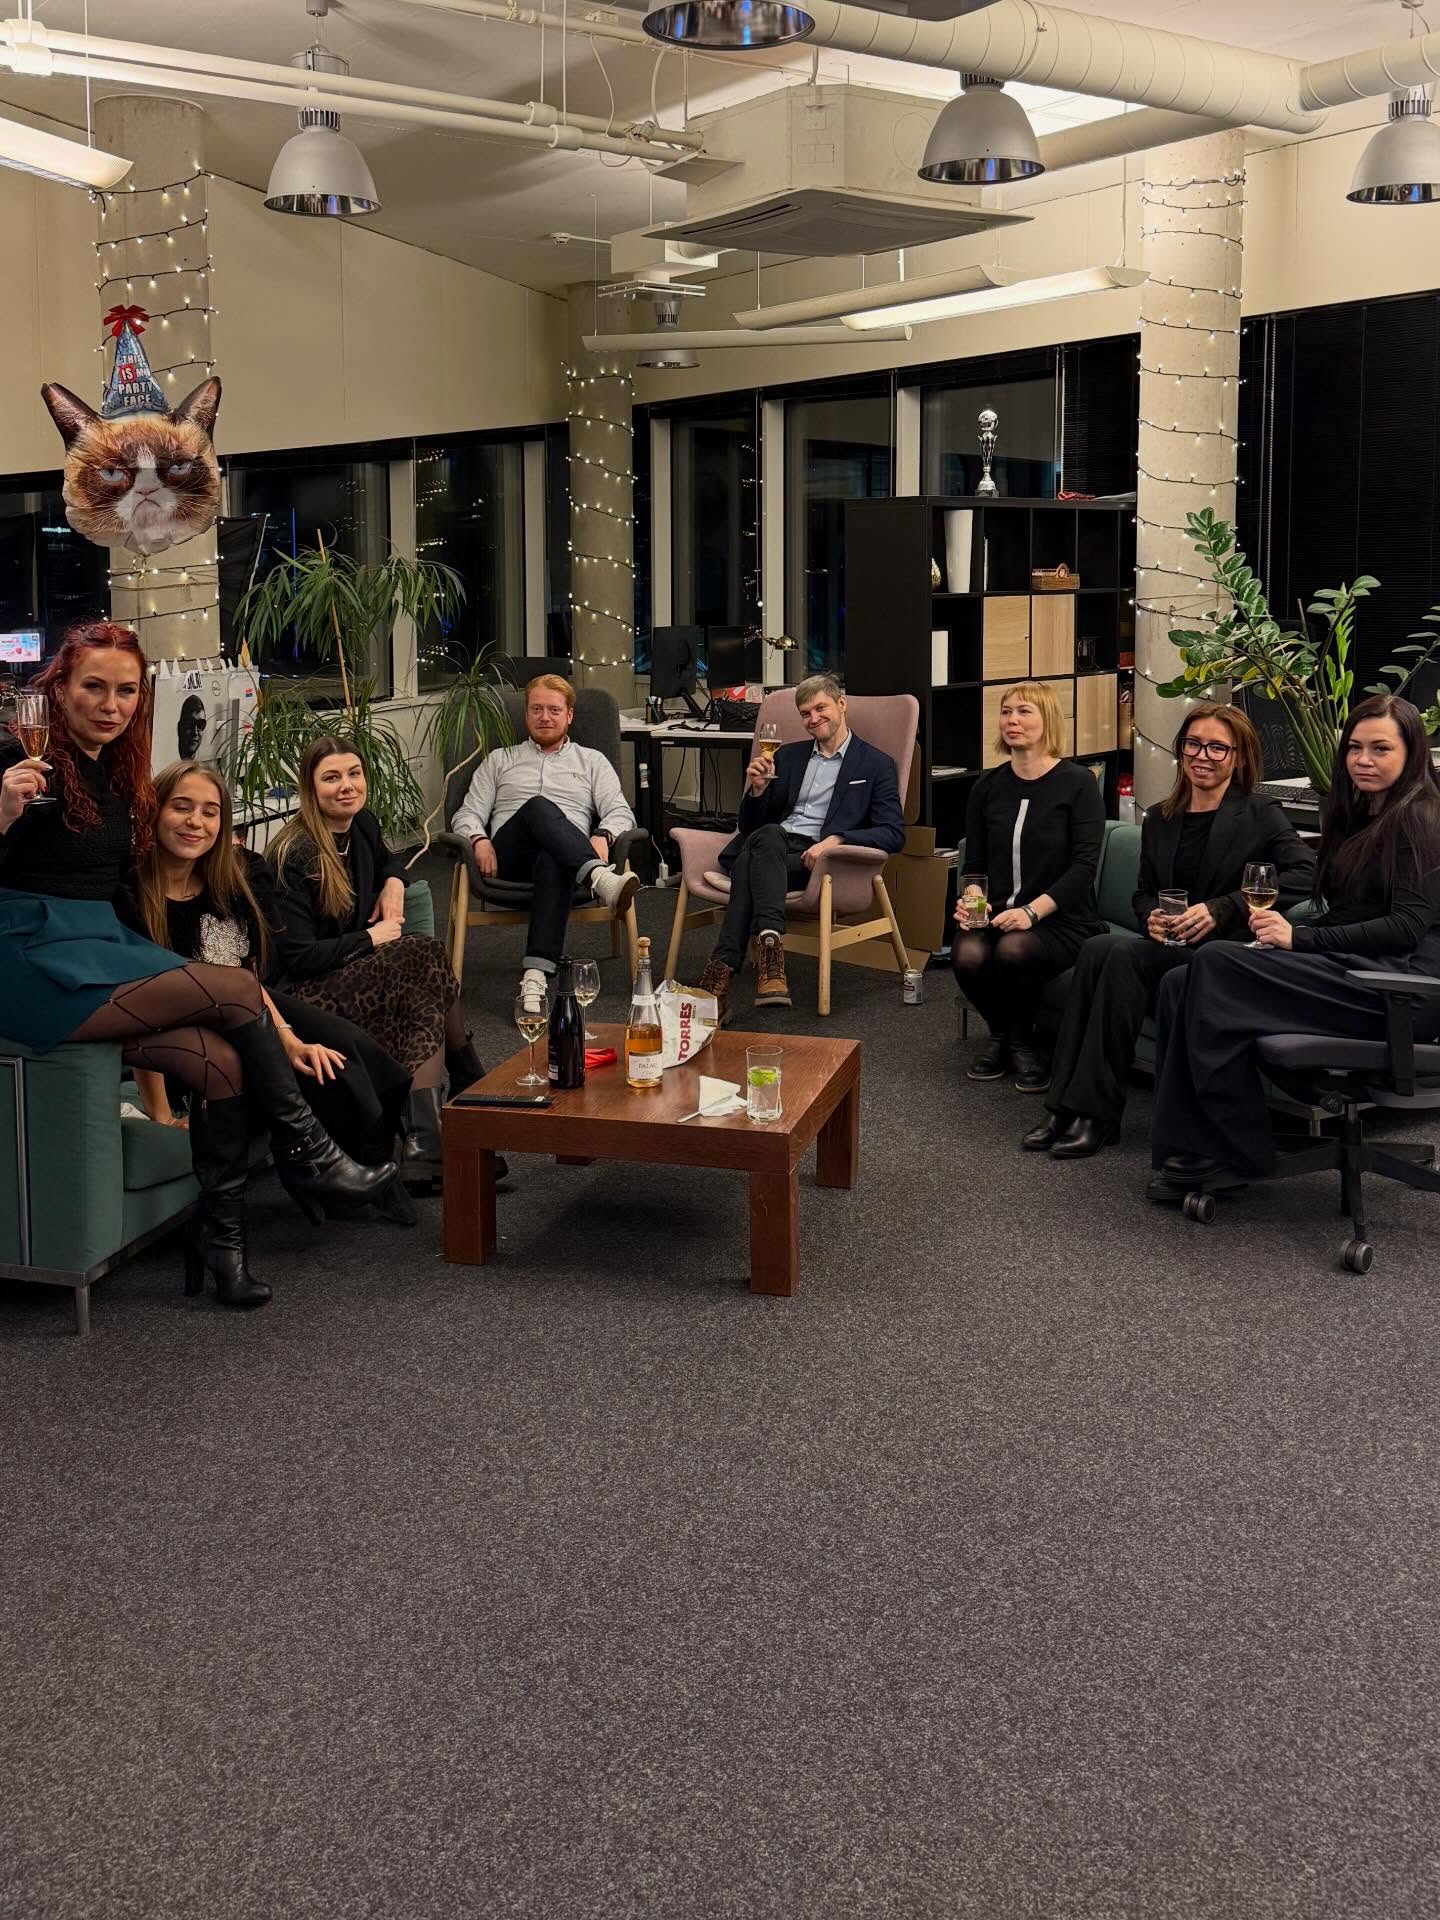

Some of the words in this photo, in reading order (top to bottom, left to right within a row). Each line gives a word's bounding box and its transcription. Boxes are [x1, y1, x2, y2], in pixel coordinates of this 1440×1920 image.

[121, 367, 134, 380] IS
[118, 381, 153, 394] PARTY
[123, 394, 151, 406] FACE
[678, 1002, 692, 1061] TORRES
